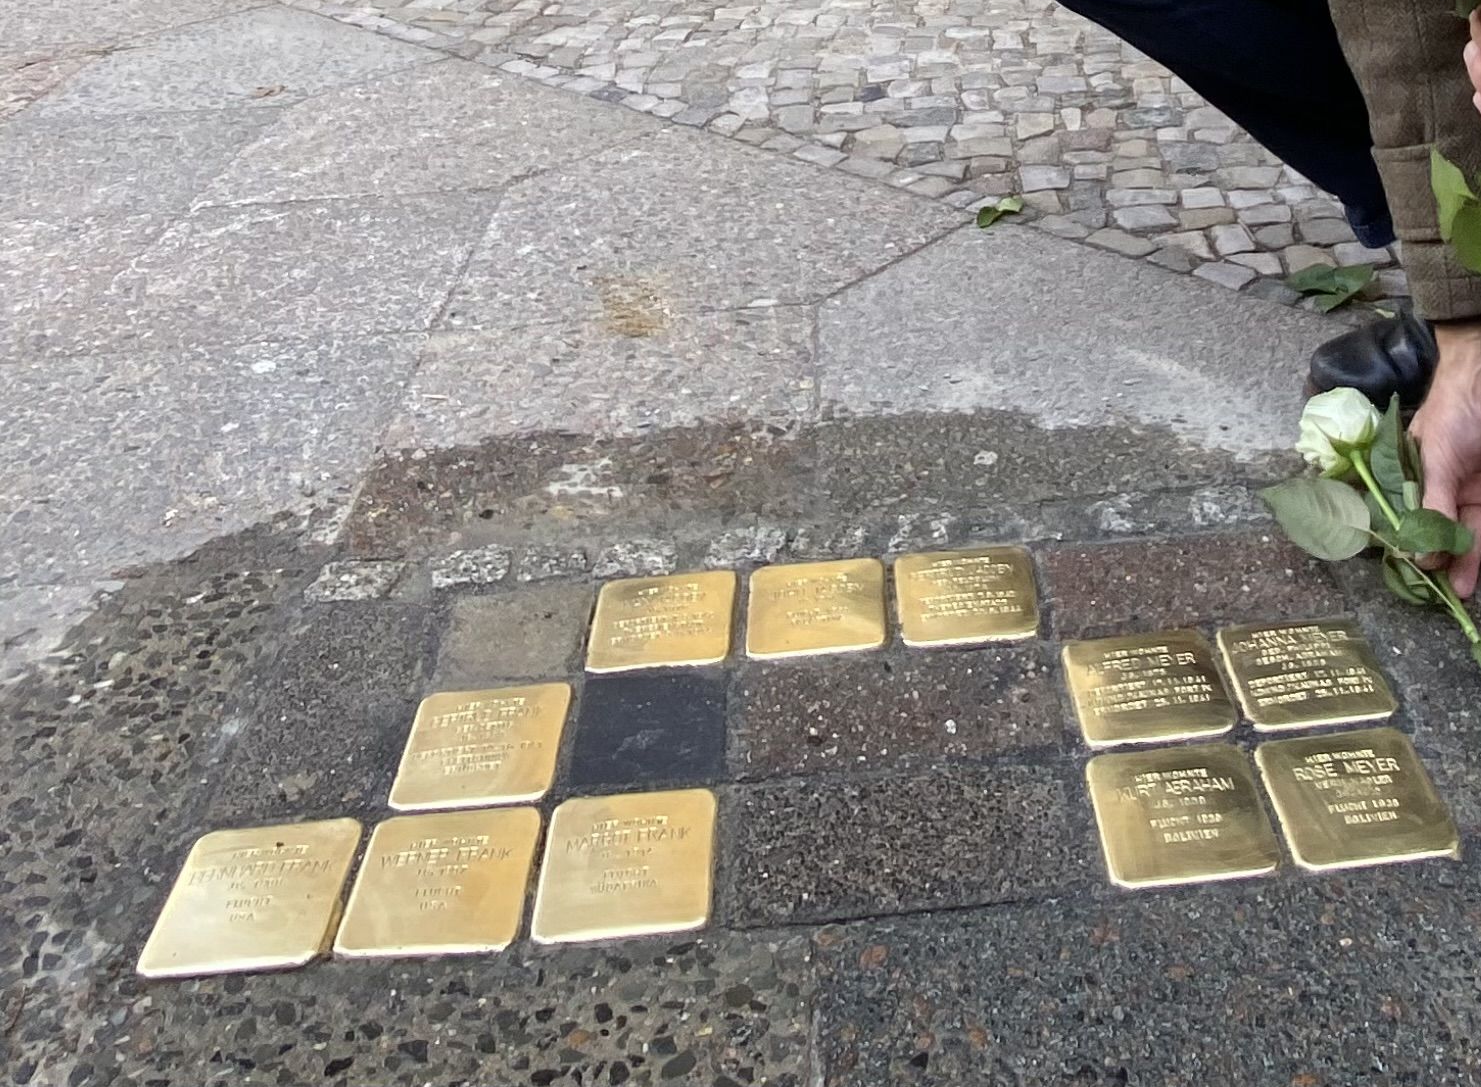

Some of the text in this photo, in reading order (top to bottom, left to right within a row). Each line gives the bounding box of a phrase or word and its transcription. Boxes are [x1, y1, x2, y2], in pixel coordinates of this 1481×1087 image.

[1292, 761, 1338, 781] ROSE
[1342, 756, 1401, 775] MEYER
[1165, 776, 1236, 795] ABRAHAM
